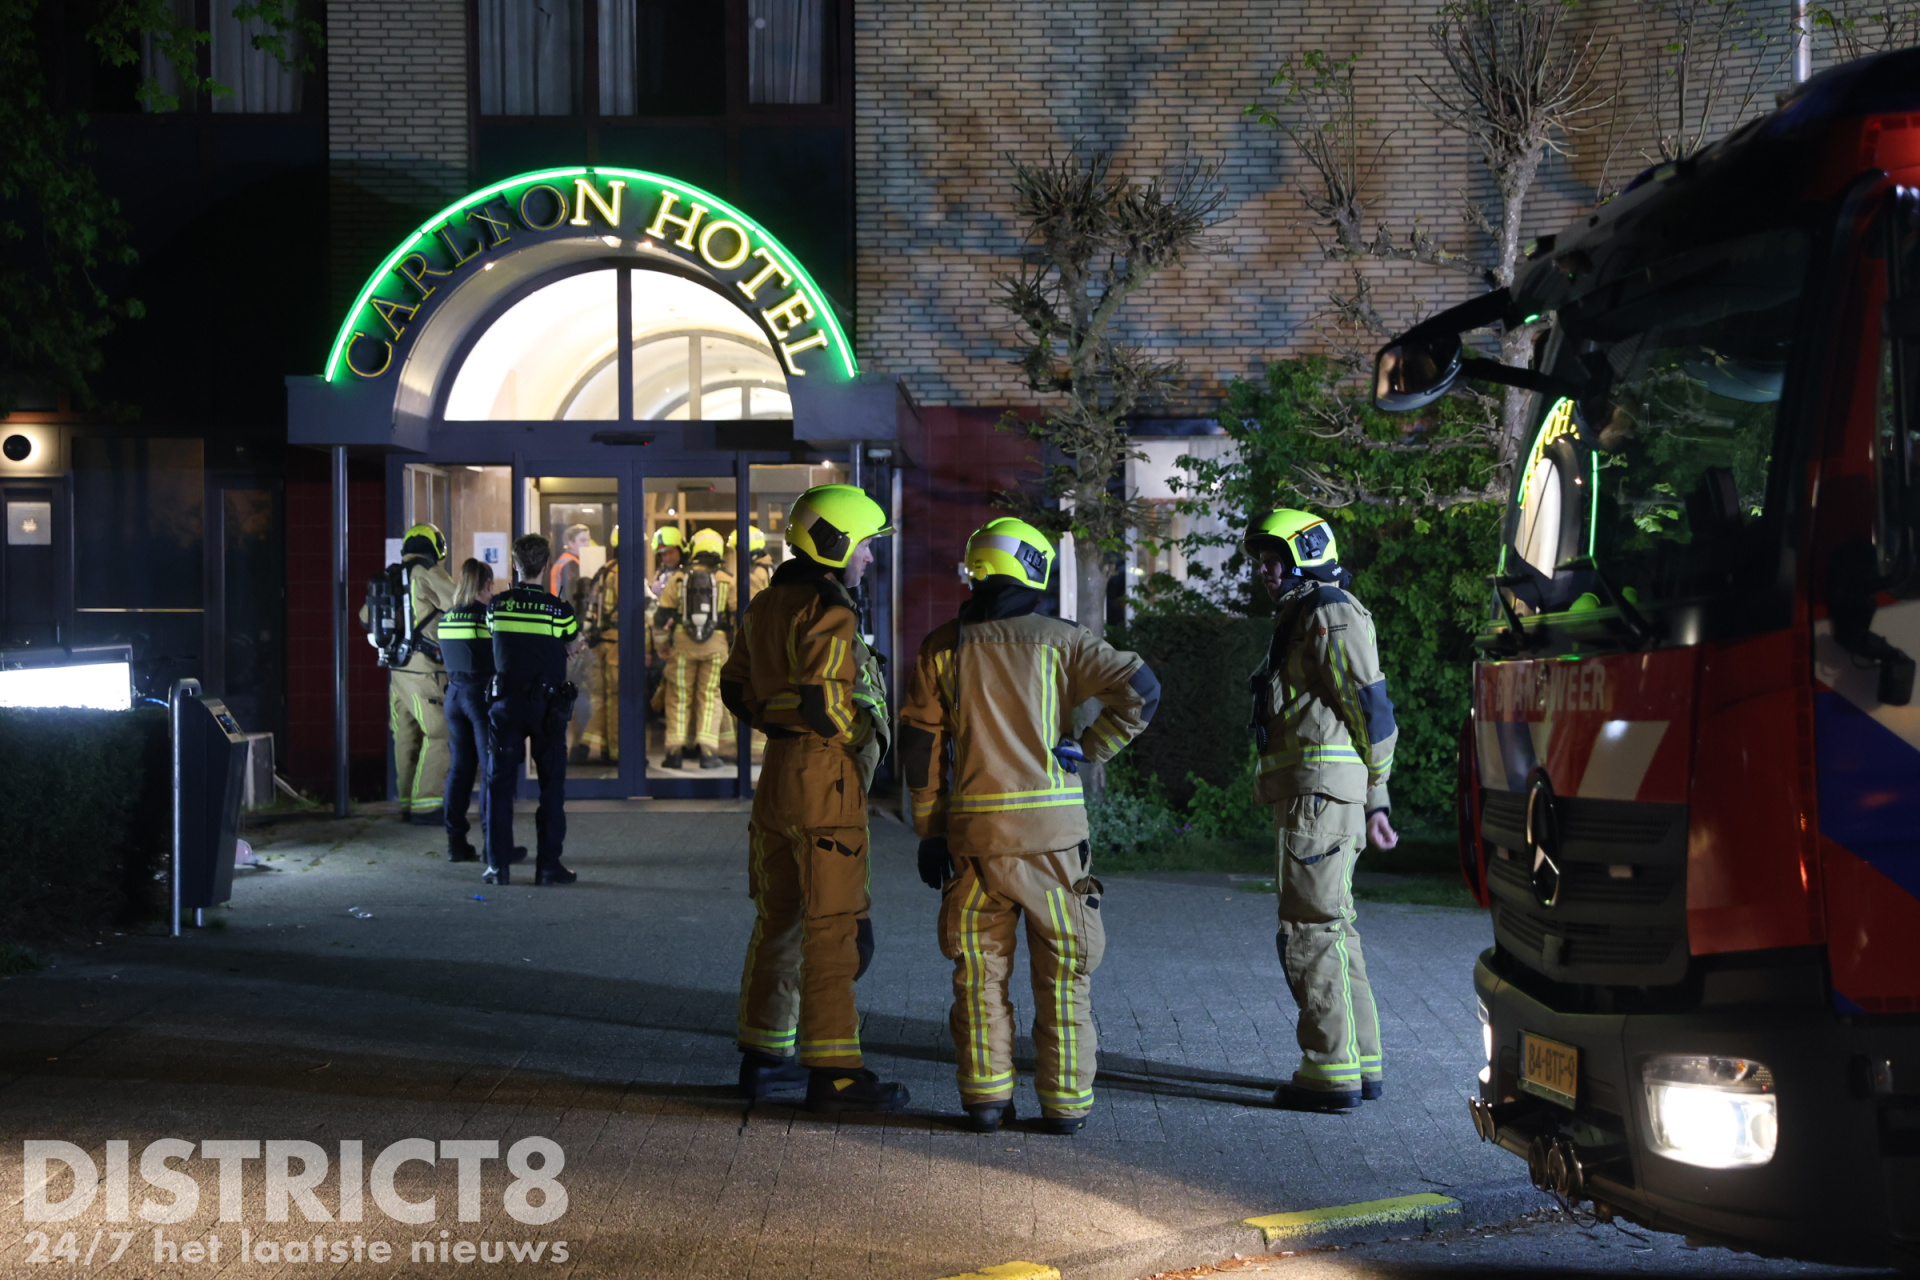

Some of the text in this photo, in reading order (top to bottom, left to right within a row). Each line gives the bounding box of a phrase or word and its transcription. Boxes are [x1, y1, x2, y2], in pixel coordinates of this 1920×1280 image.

[645, 188, 829, 377] HOTEL
[500, 597, 546, 611] POLITIE
[1528, 1043, 1575, 1091] 84-BTF-9
